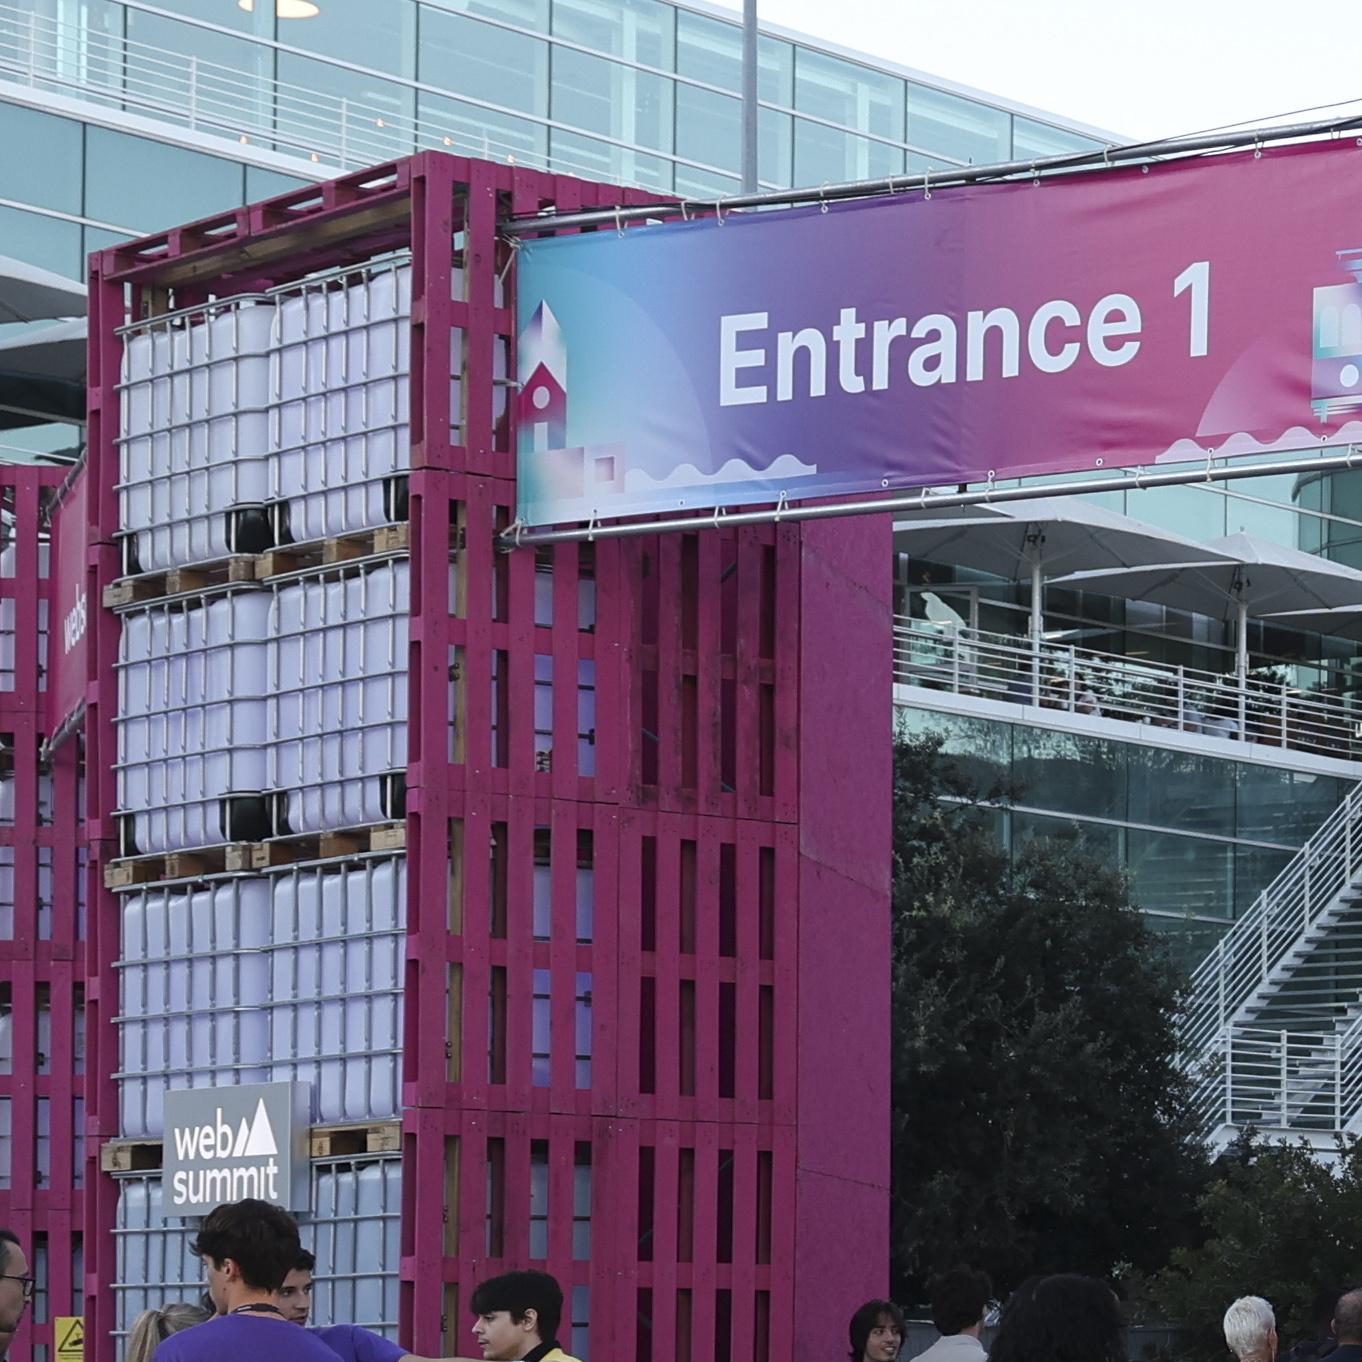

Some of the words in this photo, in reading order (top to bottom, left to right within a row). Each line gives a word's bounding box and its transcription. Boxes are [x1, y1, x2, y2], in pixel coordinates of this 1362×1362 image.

[720, 292, 1143, 407] Entrance
[1173, 260, 1210, 357] 1
[174, 1107, 233, 1161] web
[173, 1157, 279, 1205] summit
